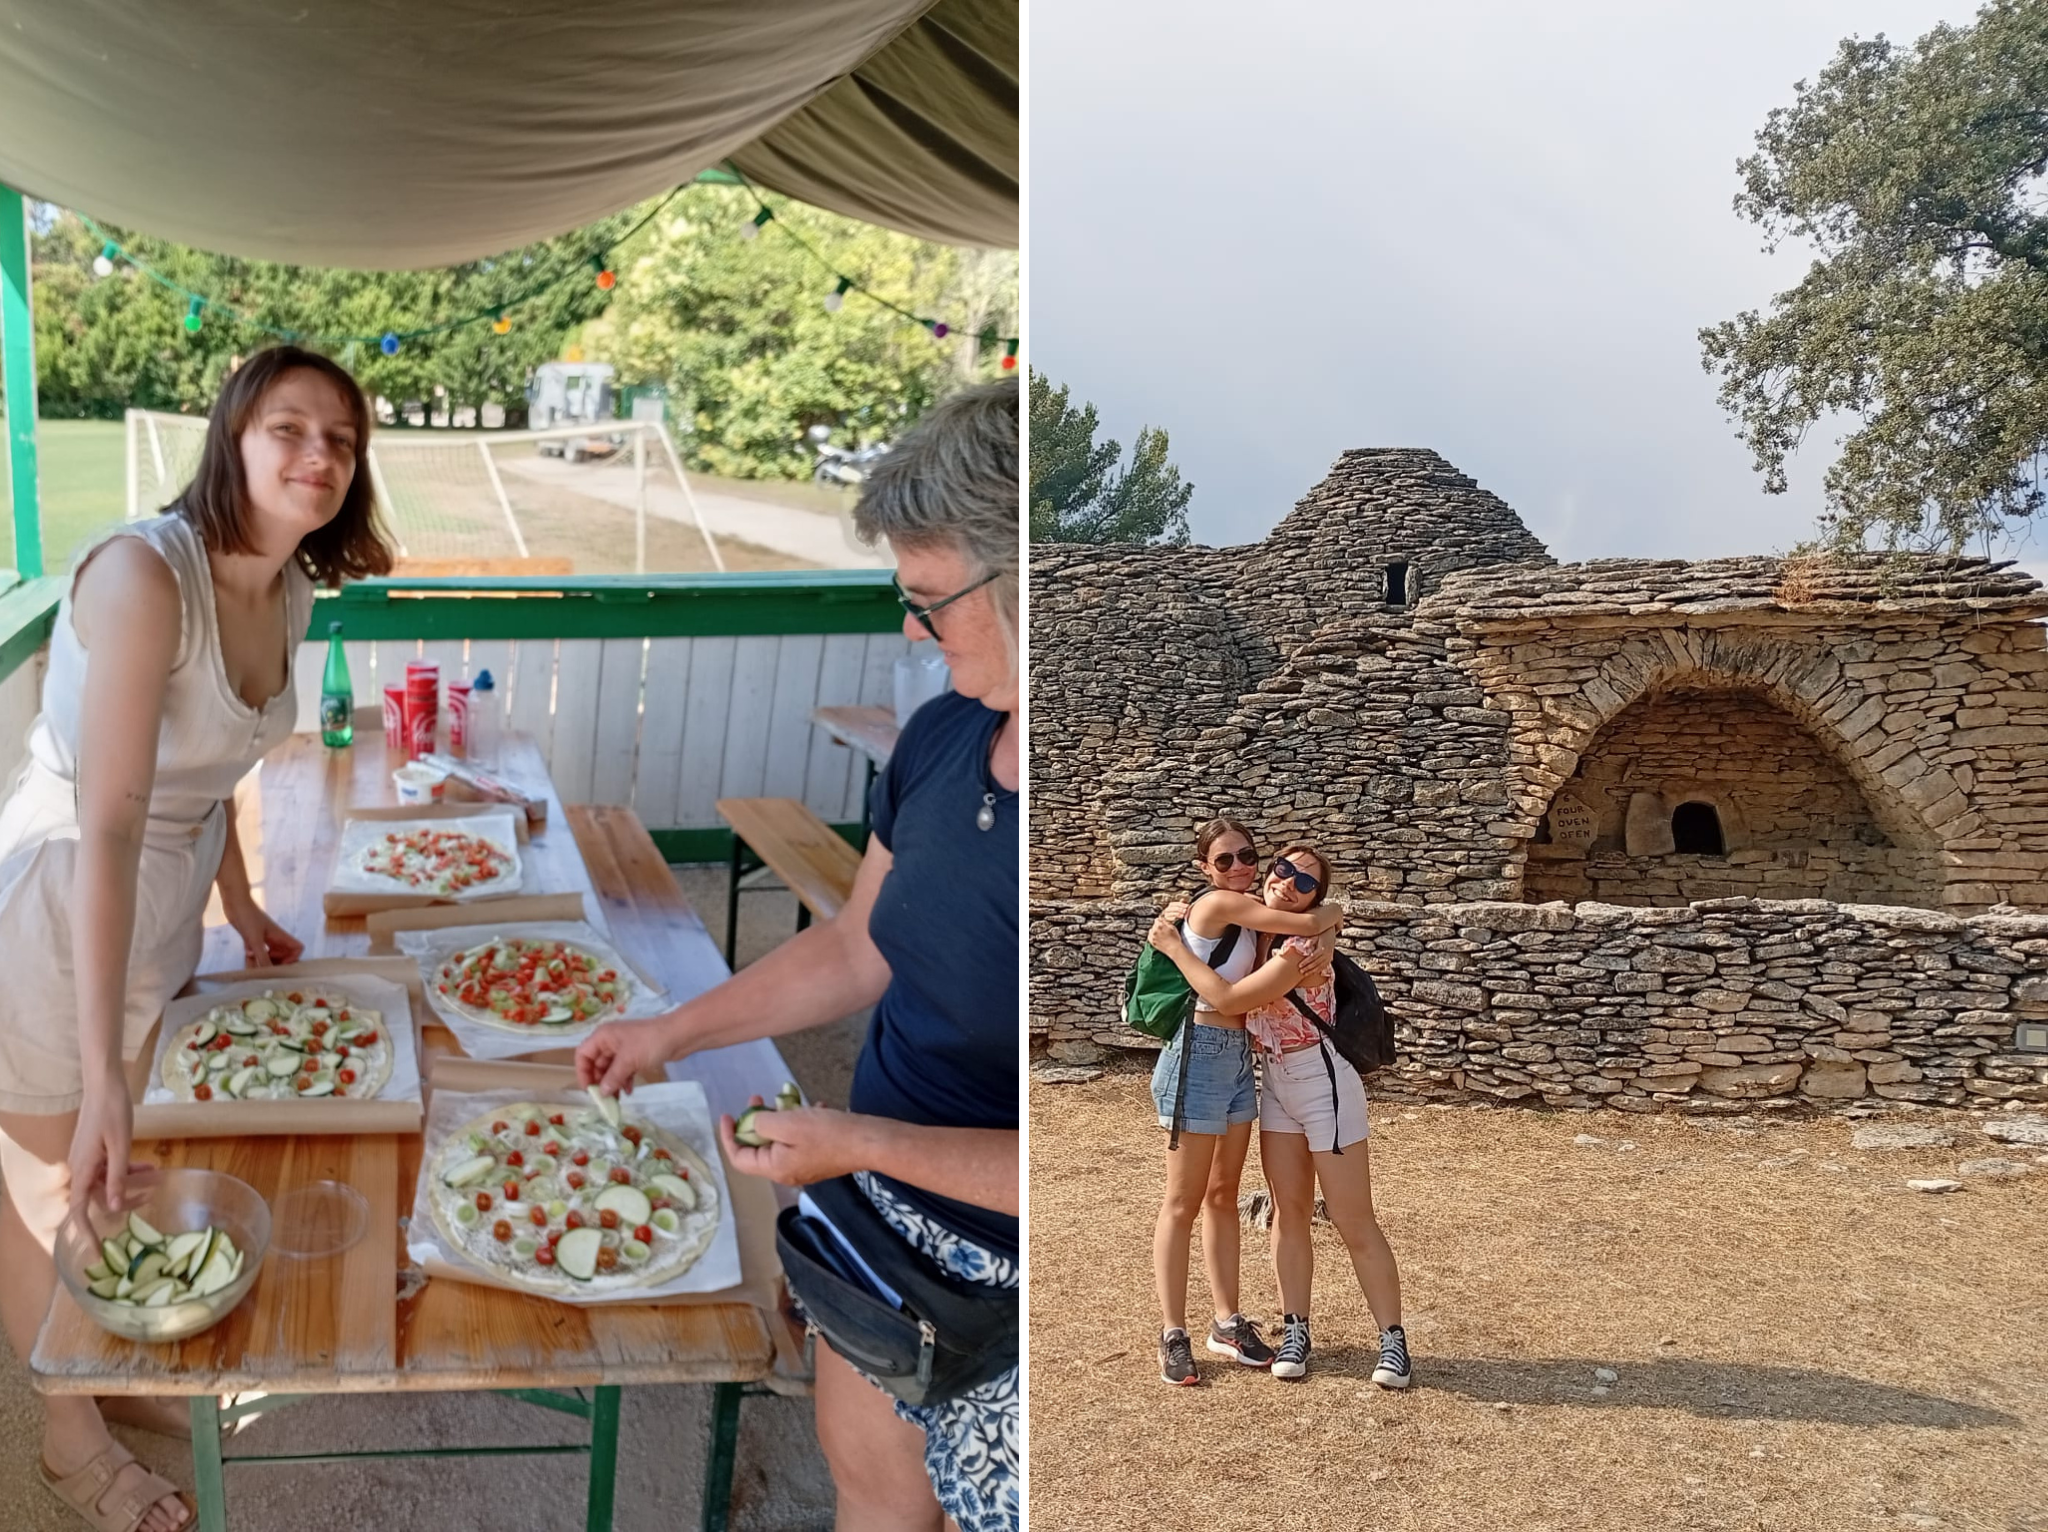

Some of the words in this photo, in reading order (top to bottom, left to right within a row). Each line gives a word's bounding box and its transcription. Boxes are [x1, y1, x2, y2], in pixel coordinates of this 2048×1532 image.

[1563, 794, 1570, 802] 6
[1557, 806, 1584, 816] FOUR
[1558, 817, 1589, 827] OVEN
[1560, 830, 1590, 839] OFEN
